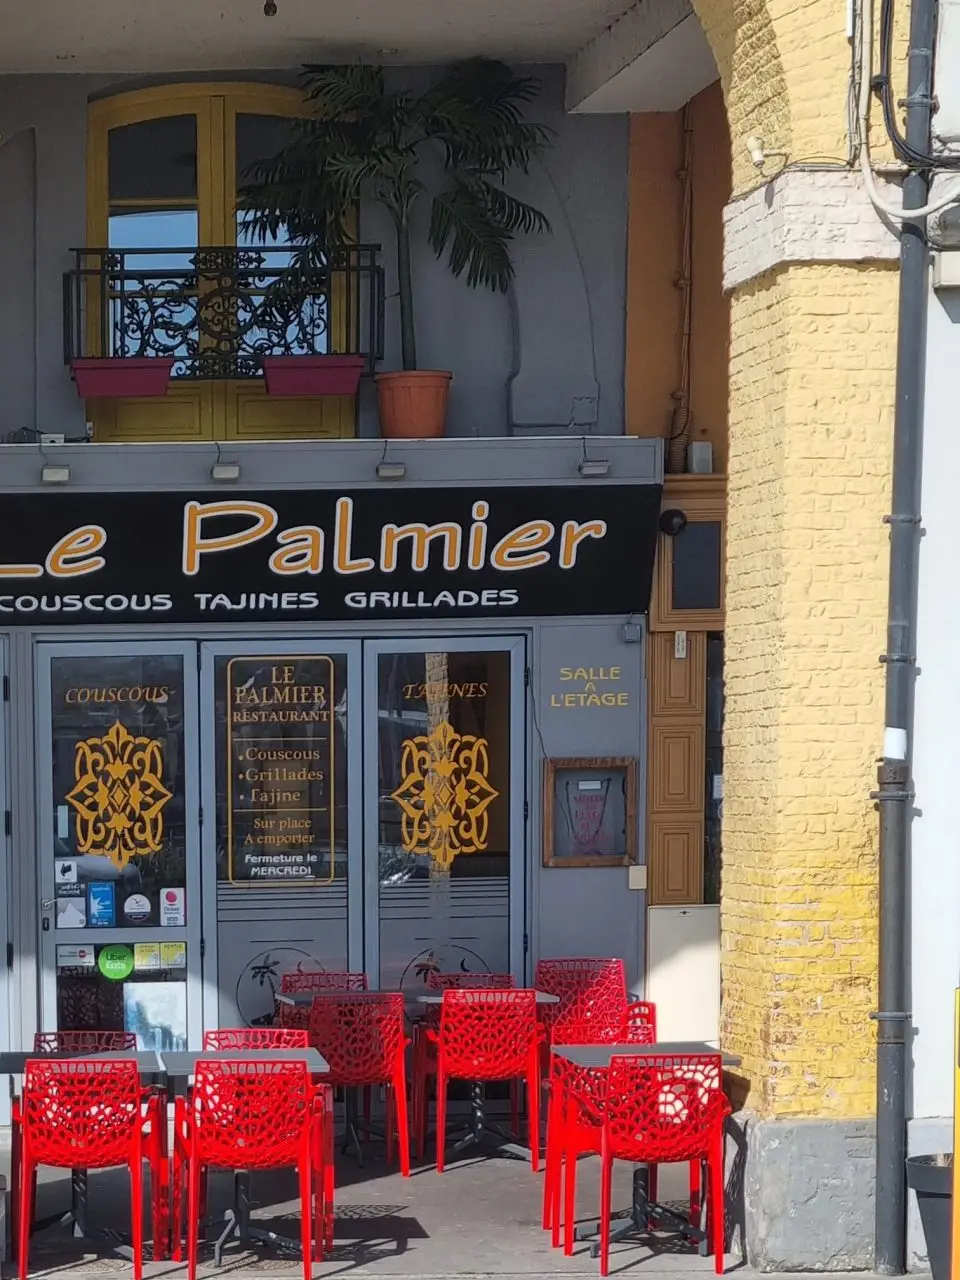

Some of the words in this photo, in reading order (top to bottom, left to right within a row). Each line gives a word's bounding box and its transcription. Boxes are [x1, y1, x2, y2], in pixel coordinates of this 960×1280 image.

[194, 592, 320, 611] TAJINES
[344, 589, 520, 608] GRILLADES
[270, 666, 296, 684] LE
[559, 667, 621, 680] SALLE
[585, 682, 596, 692] A
[65, 686, 169, 703] COUSCOUS
[234, 685, 327, 705] PALMIER
[550, 693, 629, 707] L'ETAGE
[233, 710, 330, 723] RESTAURANT
[245, 747, 320, 760] Couscous
[245, 768, 325, 781] Grillades
[251, 788, 301, 805] Tajine
[253, 818, 276, 829] Sur
[279, 817, 312, 831] place
[244, 833, 254, 845] A
[256, 833, 315, 846] emporter
[244, 854, 304, 863] Fermeture
[306, 853, 318, 862] le
[251, 866, 312, 876] MERCREDI
[105, 952, 127, 962] Uber
[106, 960, 126, 969] Eats
